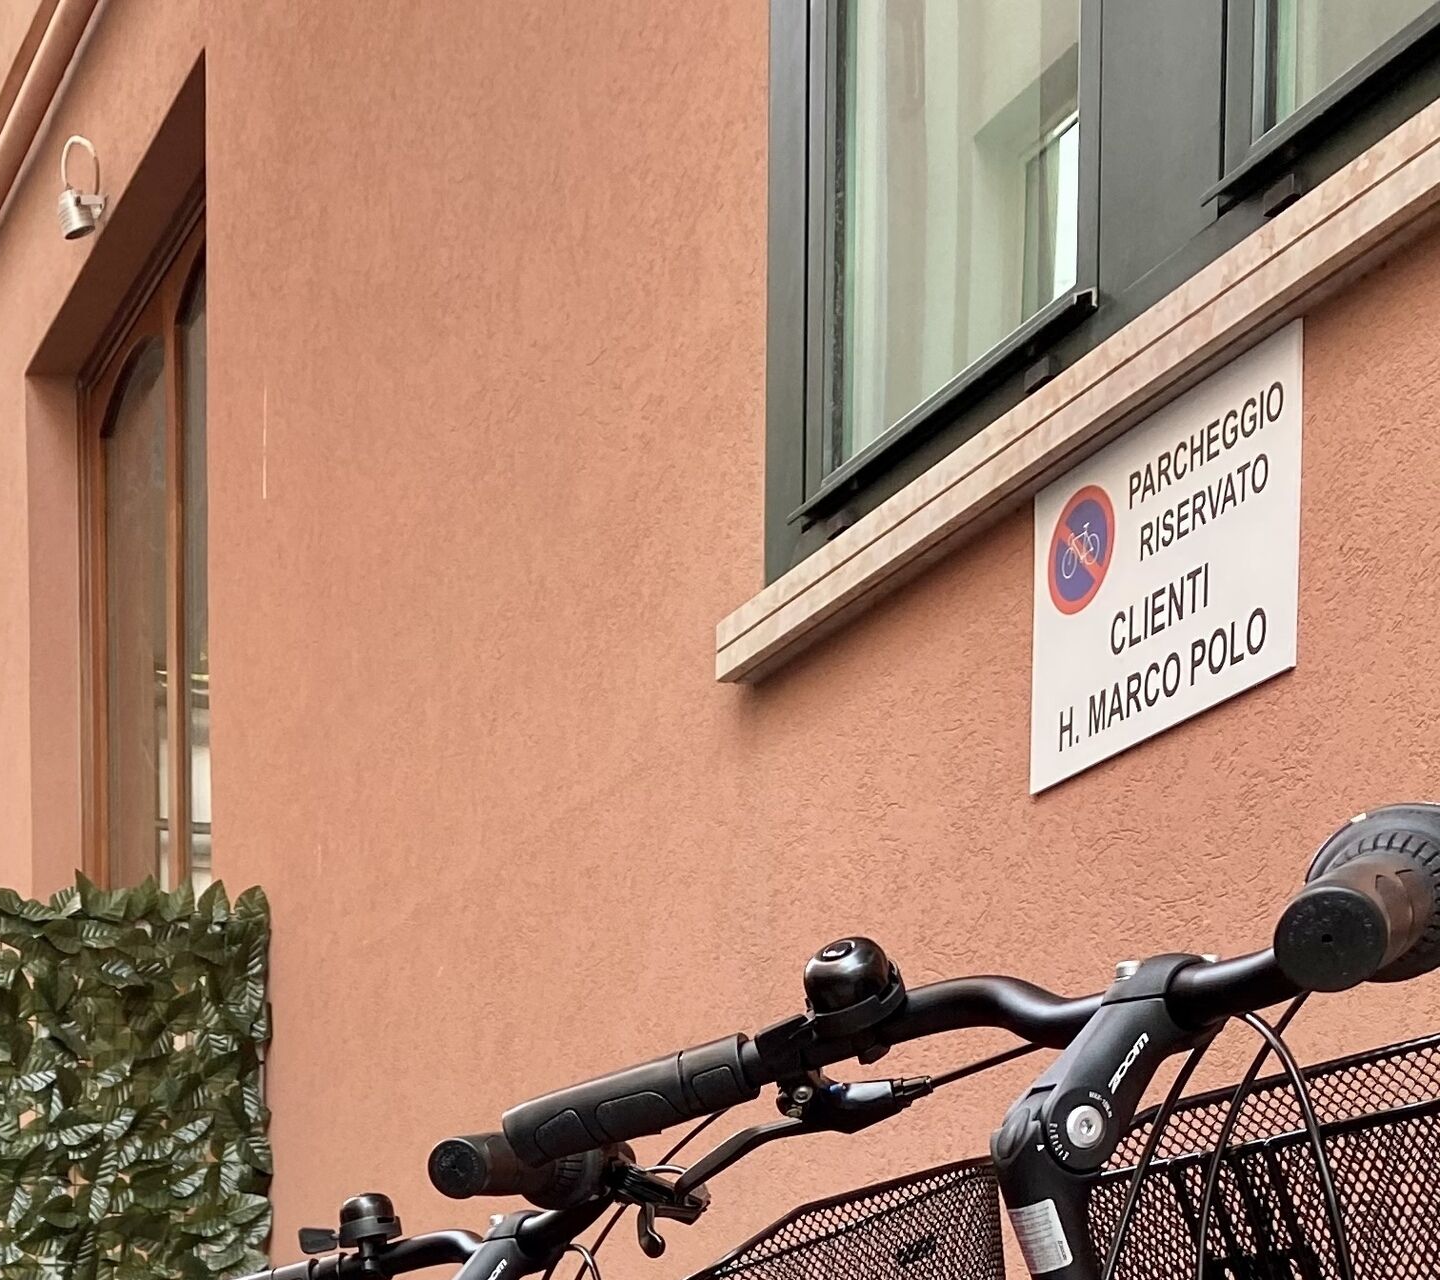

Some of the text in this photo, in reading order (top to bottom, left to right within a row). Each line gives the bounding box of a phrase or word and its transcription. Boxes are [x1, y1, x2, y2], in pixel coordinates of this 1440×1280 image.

[1128, 381, 1285, 510] PARCHEGGIO
[1139, 453, 1270, 562] RISERVATO
[1110, 562, 1210, 655] CLIENTI
[1058, 607, 1267, 752] H. MARCO POLO
